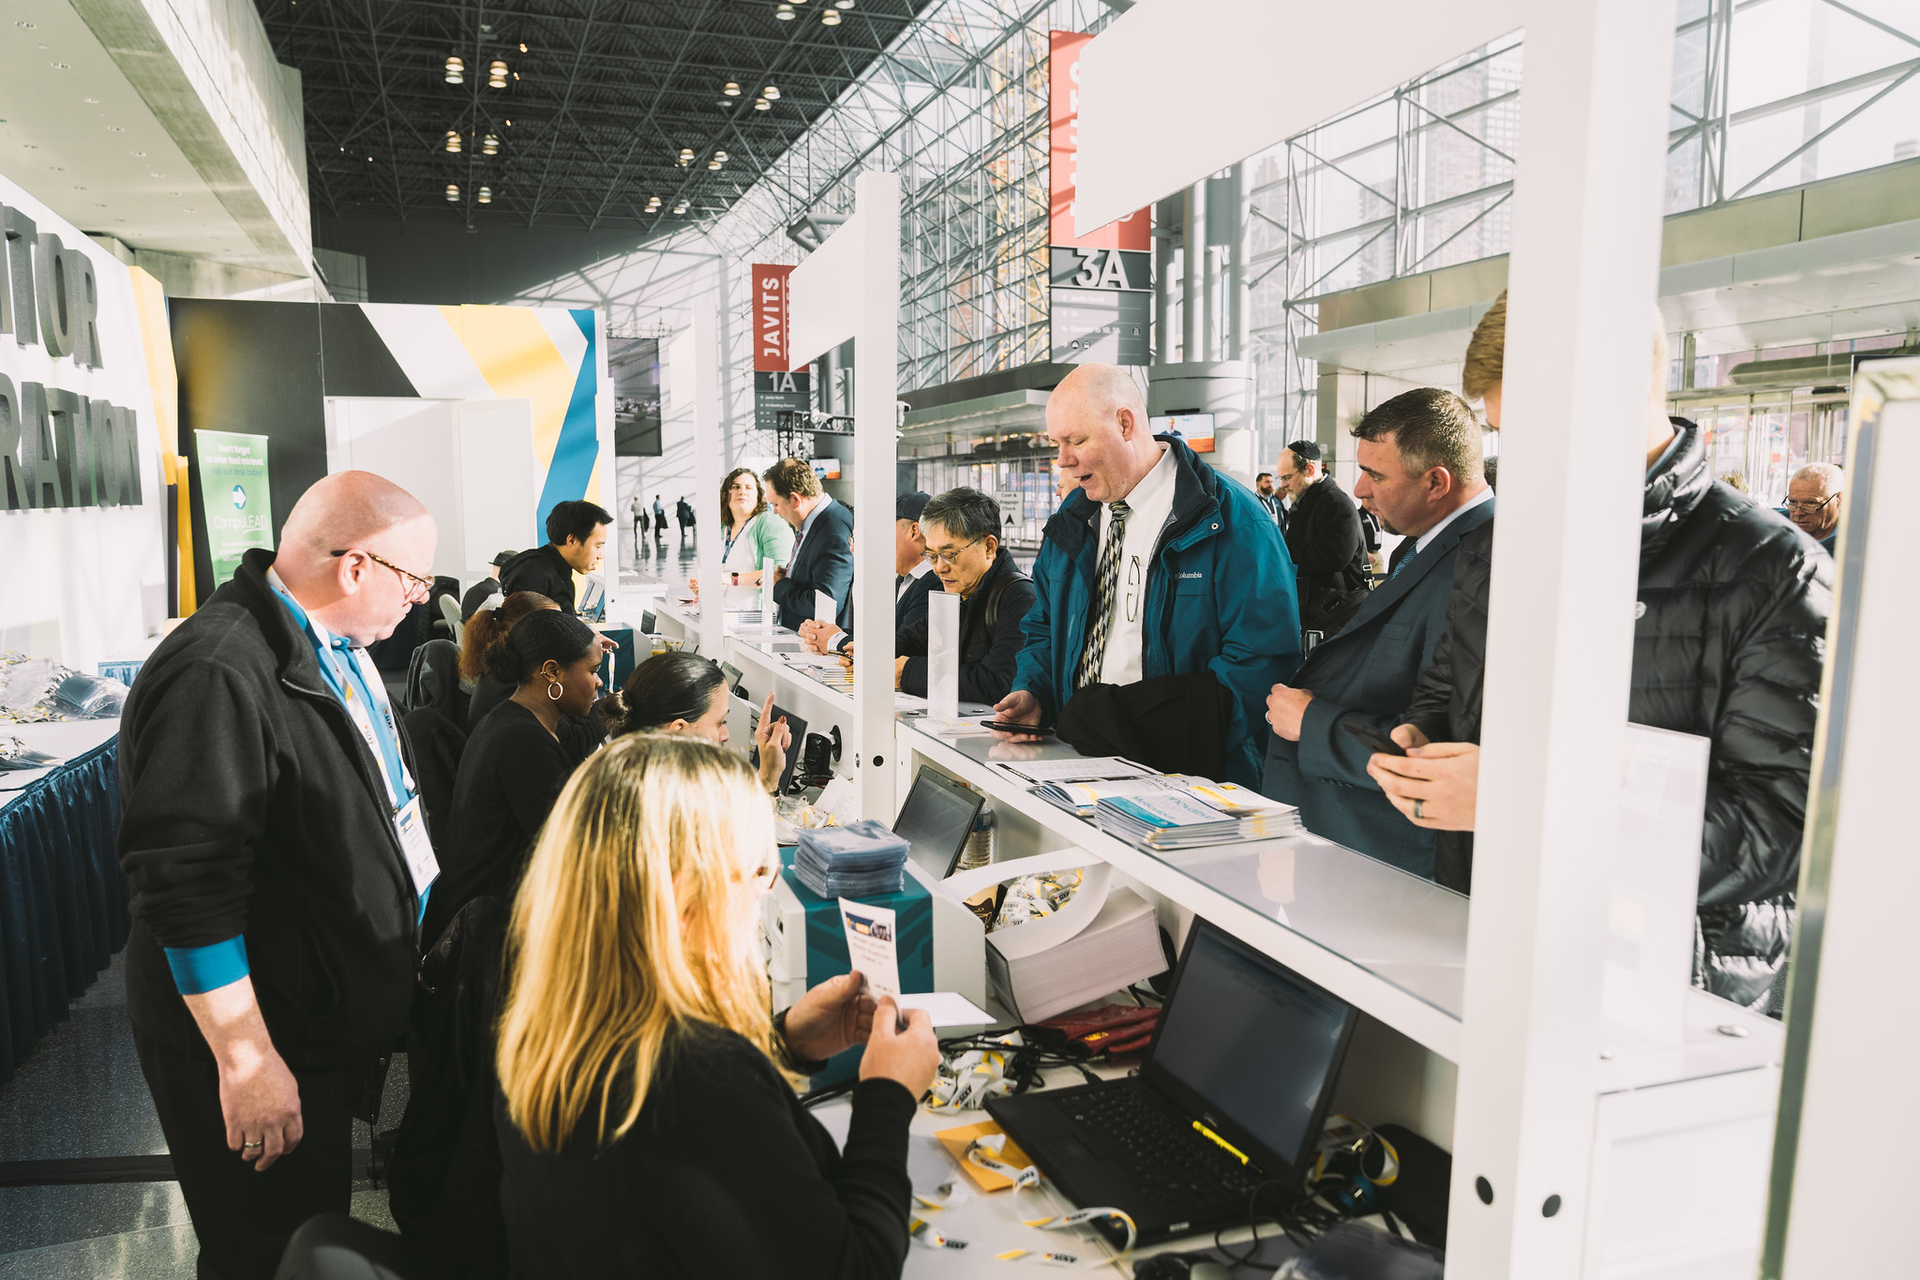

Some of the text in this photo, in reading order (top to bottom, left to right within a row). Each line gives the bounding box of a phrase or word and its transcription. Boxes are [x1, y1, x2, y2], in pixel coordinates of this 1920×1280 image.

[1075, 248, 1131, 289] 3A
[762, 277, 781, 357] JAVITS
[769, 371, 797, 392] 1A
[213, 514, 268, 530] CompuLEAD
[1178, 571, 1203, 579] Columbia
